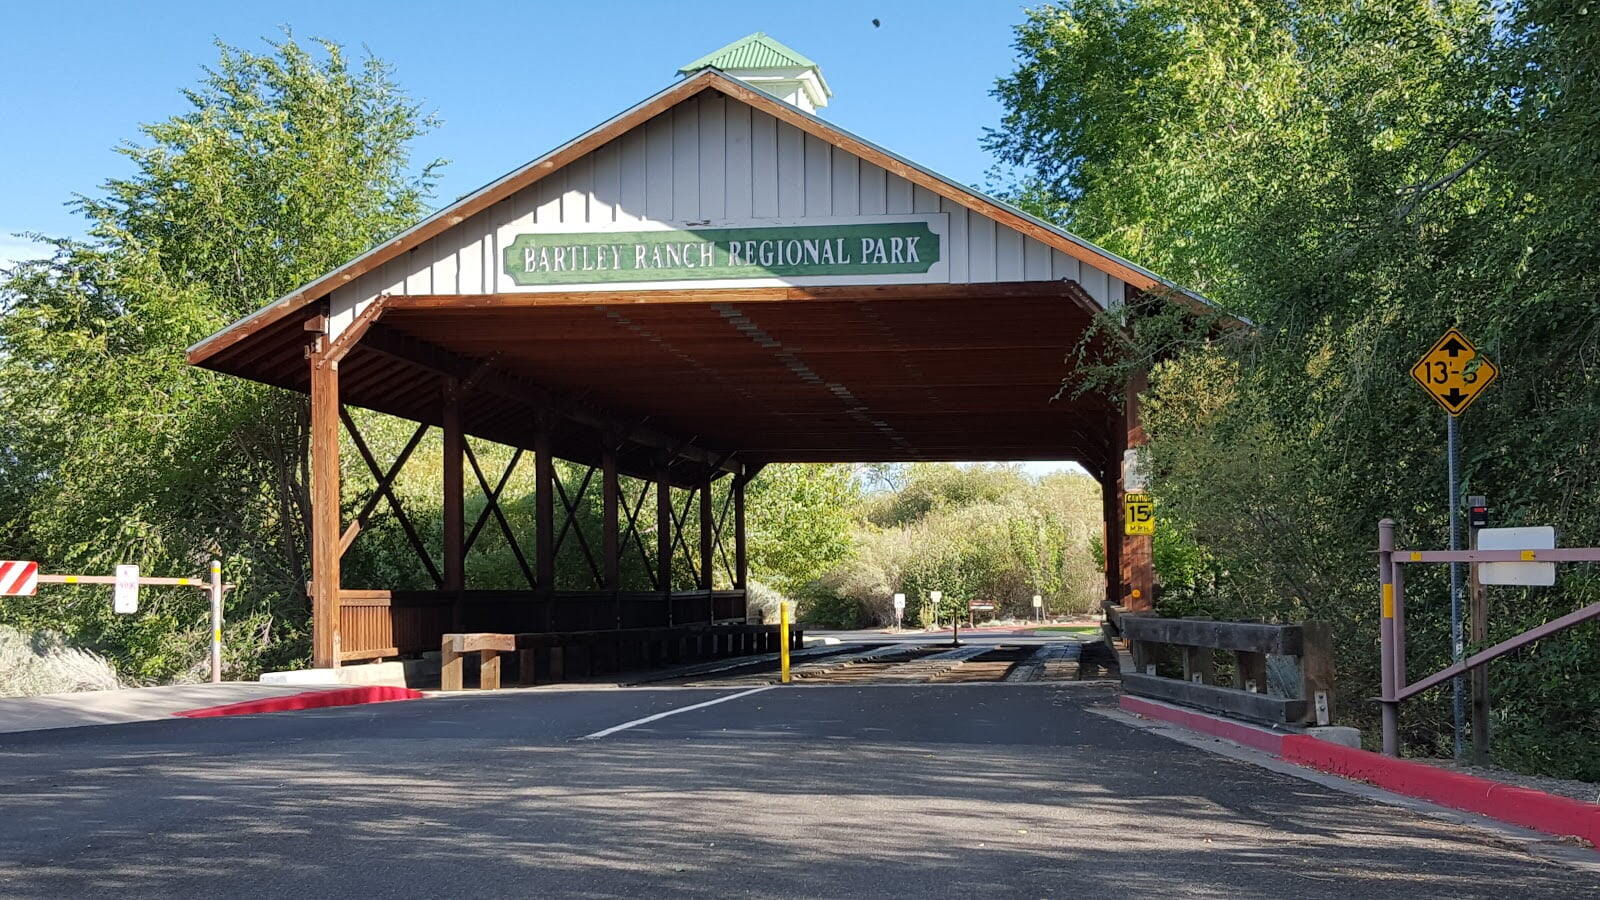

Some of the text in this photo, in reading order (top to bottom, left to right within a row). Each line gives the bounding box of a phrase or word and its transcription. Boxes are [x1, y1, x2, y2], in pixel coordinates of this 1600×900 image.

[524, 236, 920, 273] BARTLEY RANCH REGIONAL PARK
[1129, 505, 1151, 522] 15
